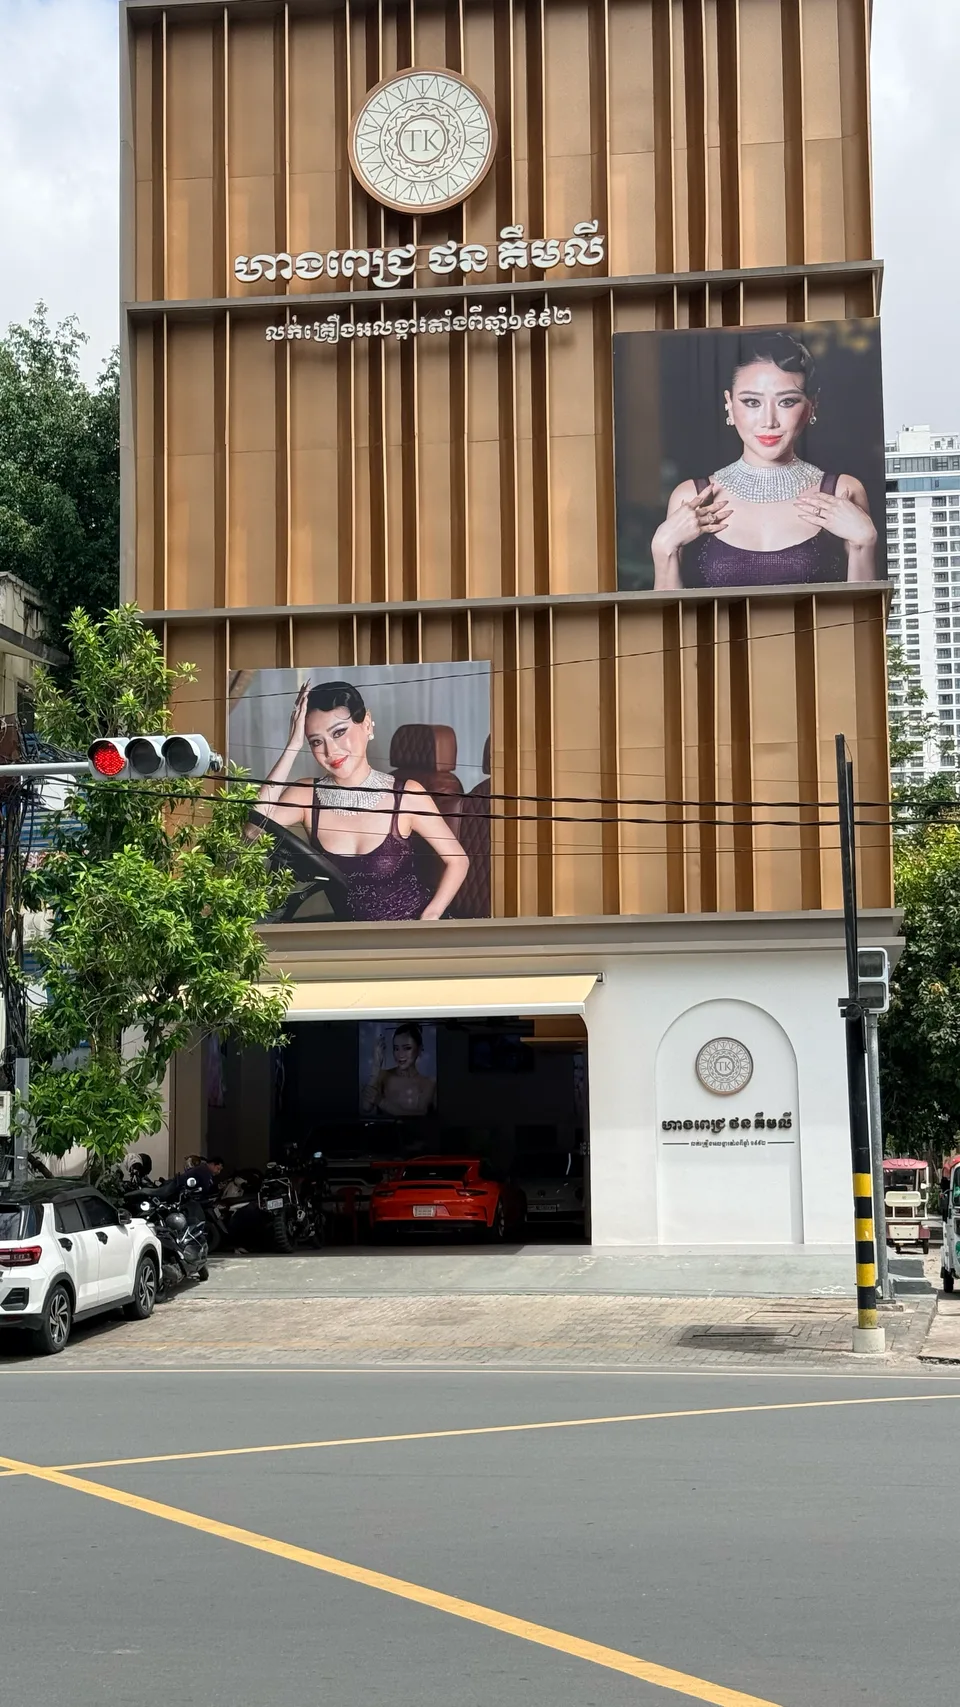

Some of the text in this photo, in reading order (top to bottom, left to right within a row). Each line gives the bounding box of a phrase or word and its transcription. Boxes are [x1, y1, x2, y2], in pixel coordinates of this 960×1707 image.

[403, 129, 441, 152] TK
[234, 243, 417, 288] ហាងពេជ្រ
[428, 240, 489, 275] ថន
